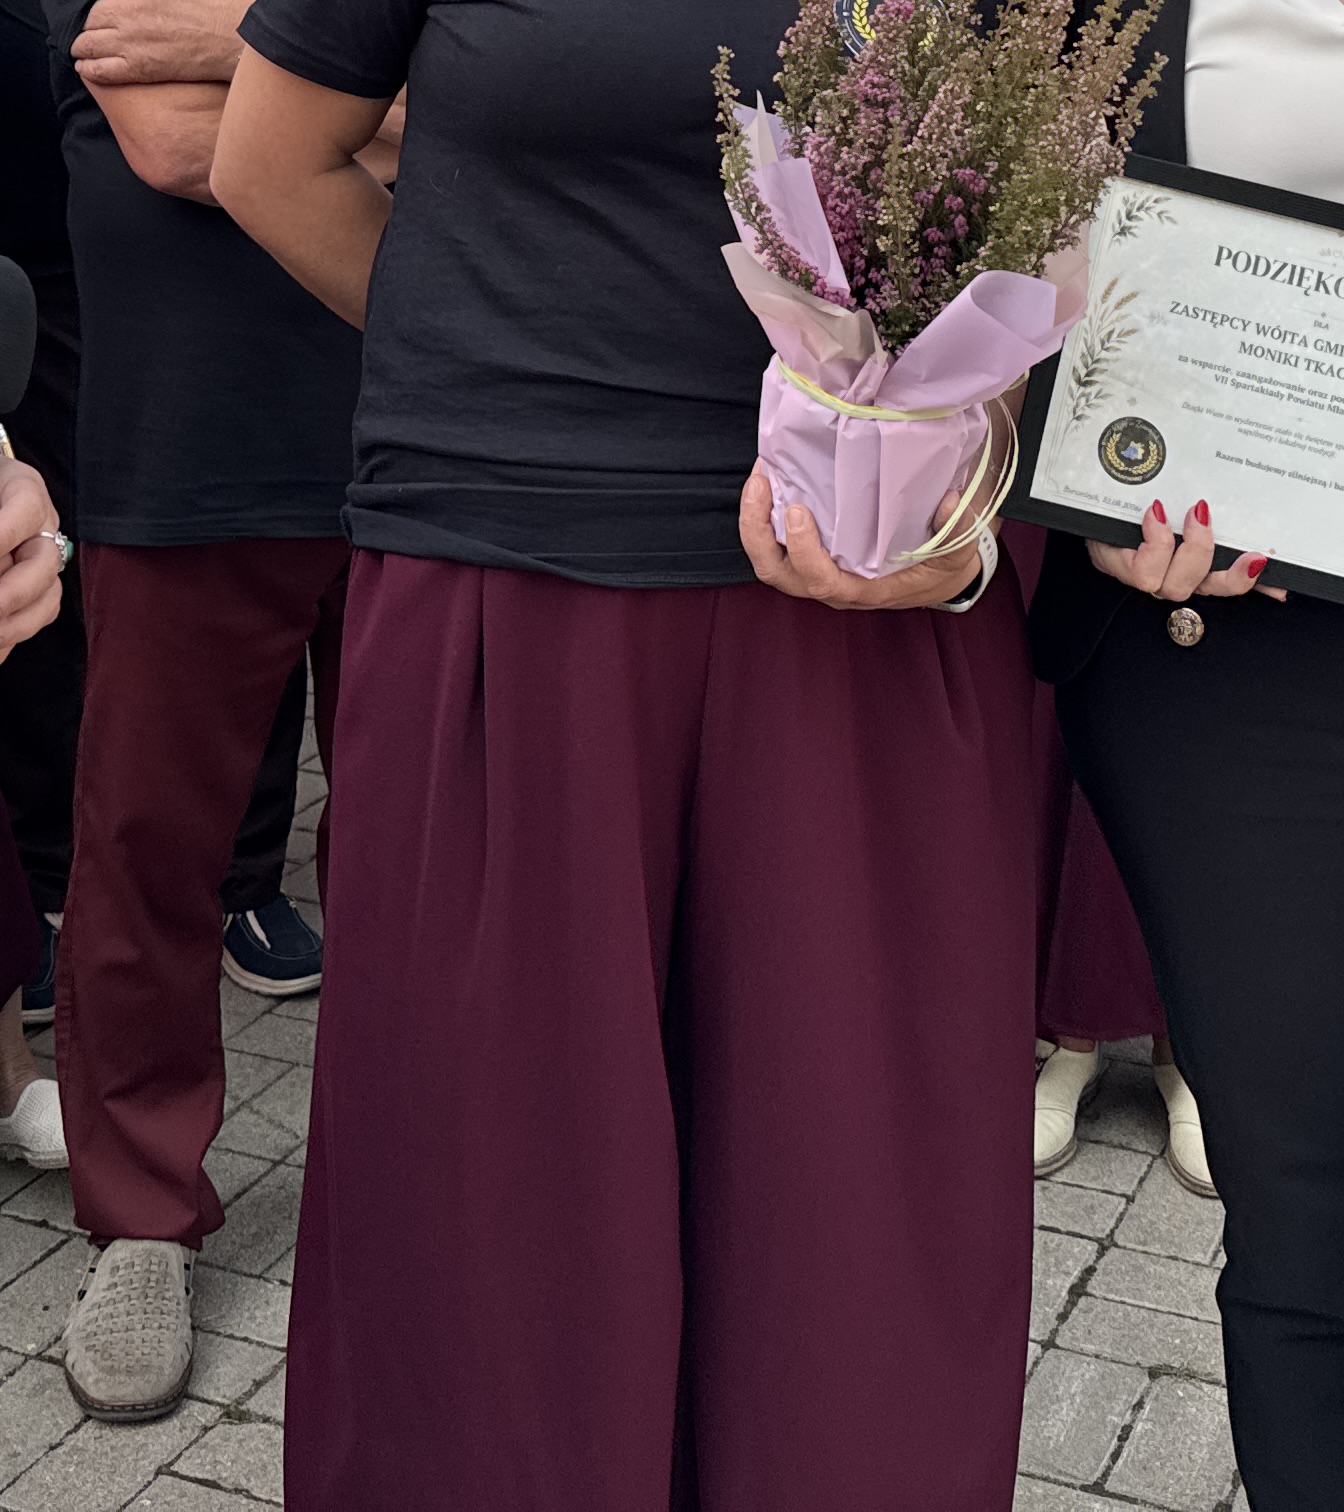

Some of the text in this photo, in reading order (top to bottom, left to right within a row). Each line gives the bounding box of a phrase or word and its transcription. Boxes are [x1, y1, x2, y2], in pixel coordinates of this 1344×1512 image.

[1170, 301, 1250, 331] ZASTĘPCY
[1256, 323, 1308, 348] WÓJTA
[1313, 319, 1330, 331] DLA
[1239, 341, 1300, 368] MONIKI
[1177, 354, 1189, 363] za
[1236, 371, 1305, 393] zaangażowanie
[1307, 389, 1329, 400] oraz
[1214, 373, 1229, 385] VII
[1230, 378, 1285, 401] Spartakiady
[1286, 393, 1325, 410] Powiatu
